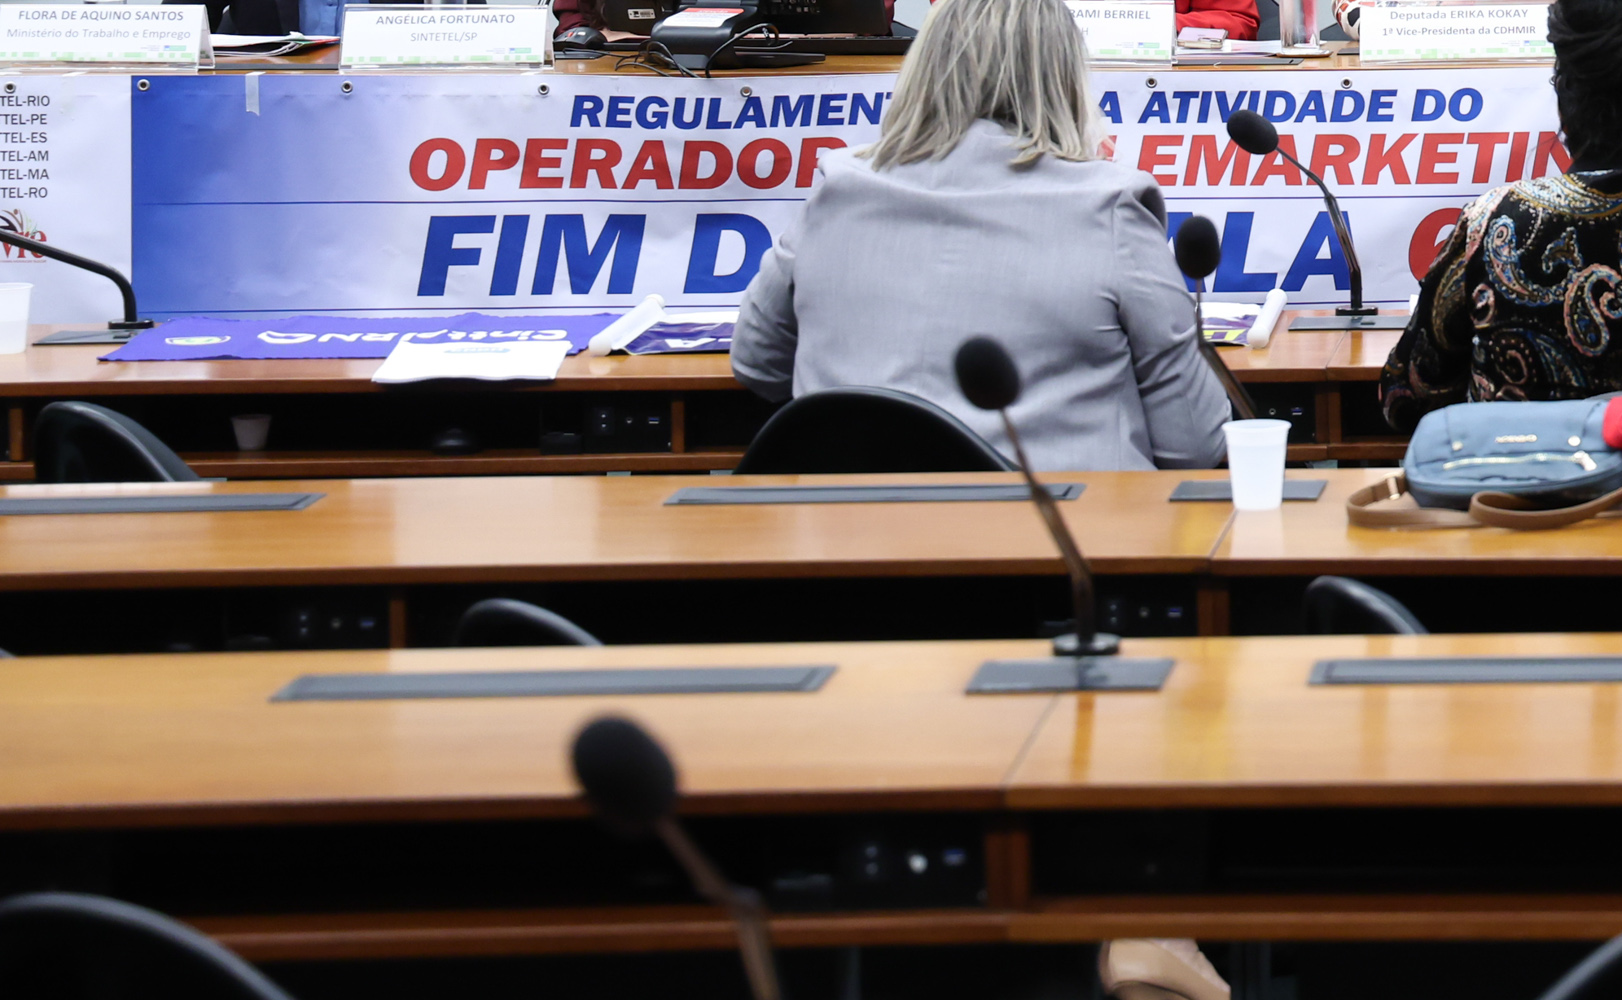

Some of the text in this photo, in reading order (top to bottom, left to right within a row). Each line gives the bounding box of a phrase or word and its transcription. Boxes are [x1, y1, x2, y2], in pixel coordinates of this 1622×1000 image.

[18, 10, 184, 21] FLORA DE AQUINO SANTOS
[376, 13, 515, 24] ANGÉLICA FORTUNATO
[1069, 9, 1151, 19] RAMI BERRIEL
[1390, 9, 1528, 21] Deputada ERIKA KOKAY
[6, 28, 62, 38] Ministério
[65, 28, 79, 38] do
[83, 28, 130, 38] Trabalho
[142, 29, 191, 40] Emprego
[1396, 26, 1475, 36] Vice-Presidenta
[1478, 26, 1491, 35] da
[1493, 25, 1536, 35] CDHMIR
[410, 32, 478, 42] SINTETEL/SP
[0, 95, 50, 107] TEL-RIO
[570, 92, 893, 130] REGULAMEN
[1137, 89, 1398, 124] ATIVIDADE
[1411, 87, 1484, 122] DO
[0, 113, 48, 125] TEL-PE
[0, 132, 48, 143] TEL-ES
[0, 150, 49, 161] TEL-AM
[1097, 131, 1573, 186] EMARKETIN
[0, 169, 49, 180] TEL-MA
[0, 187, 48, 198] TEL-RO
[416, 213, 647, 297] FIM
[682, 212, 773, 294] D
